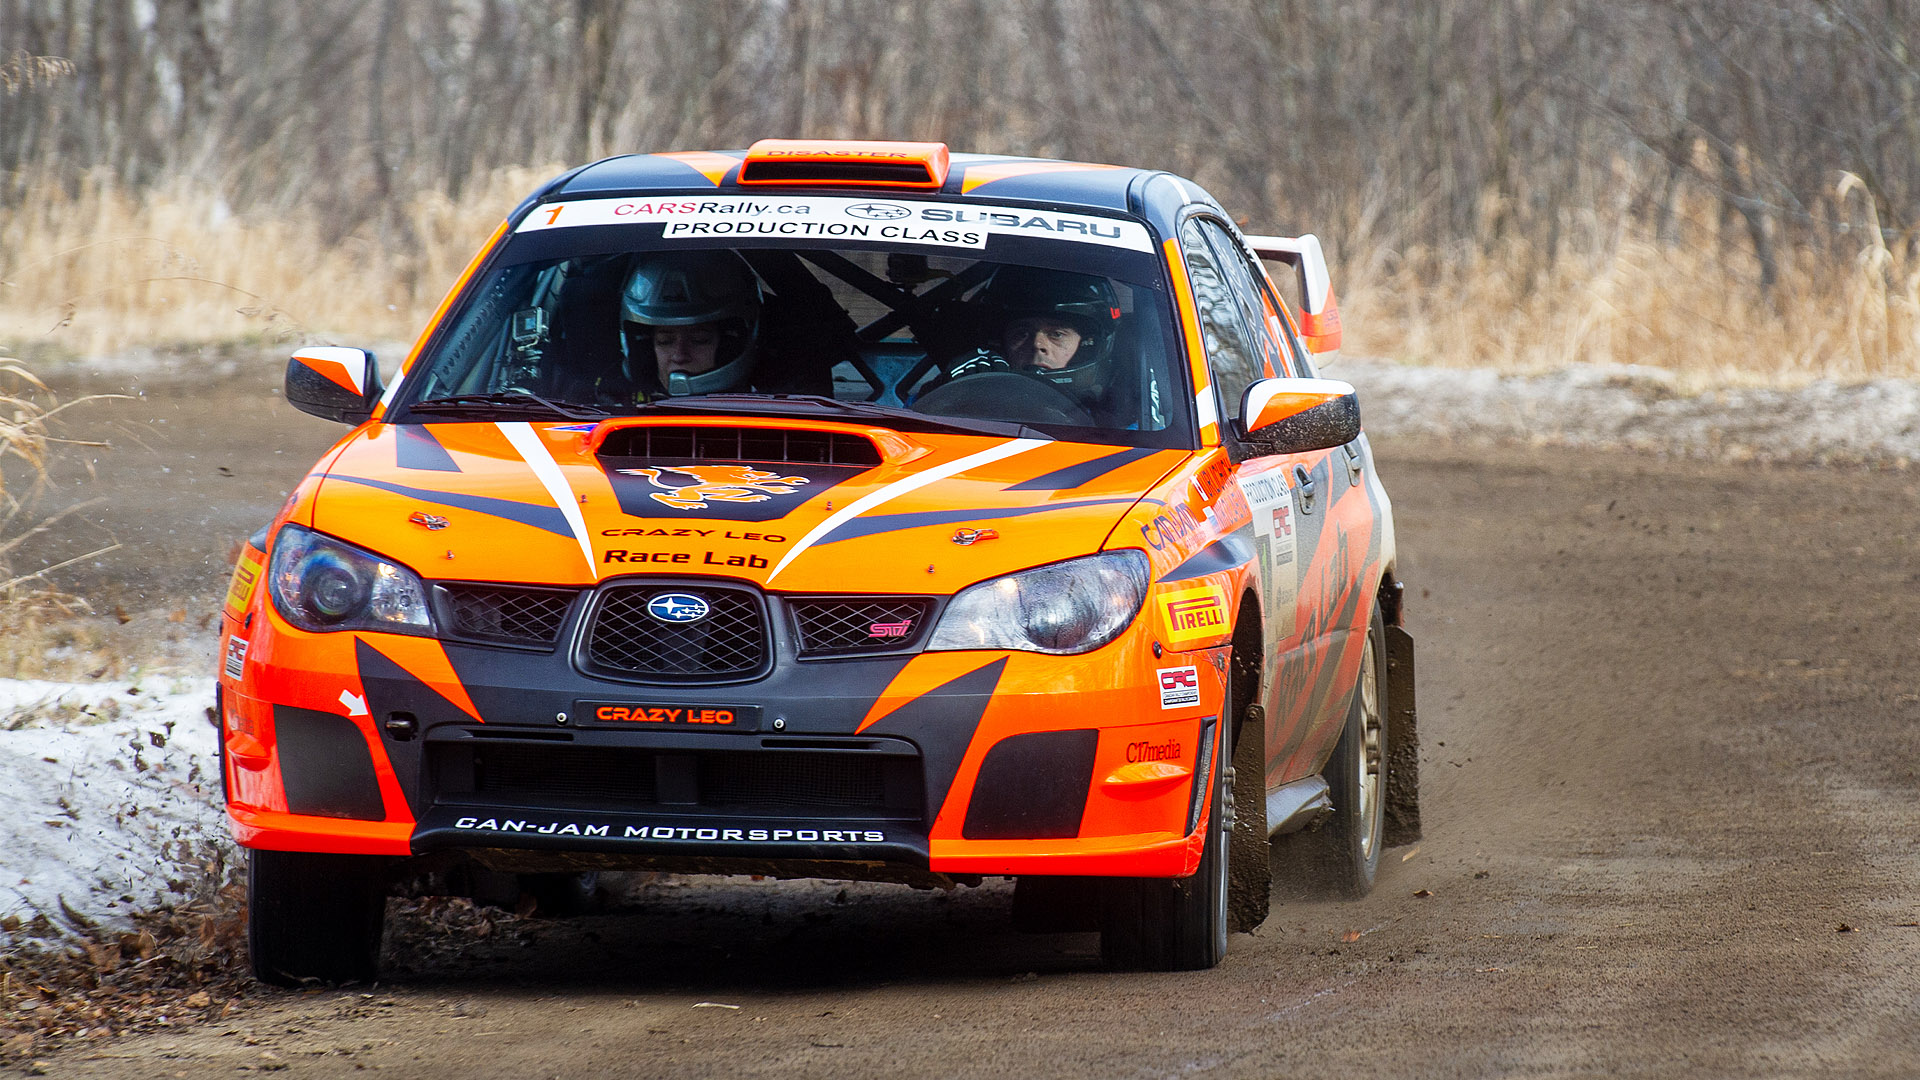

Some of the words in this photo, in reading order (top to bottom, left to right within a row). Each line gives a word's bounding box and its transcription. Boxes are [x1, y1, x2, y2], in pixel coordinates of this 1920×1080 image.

[767, 150, 908, 159] DISASTER
[545, 205, 564, 226] 1
[614, 201, 811, 217] CARSRally.ca
[671, 222, 870, 237] PRODUCTION
[881, 226, 980, 245] CLASS
[921, 208, 1121, 239] SUBARU
[601, 528, 717, 537] CRAZY
[724, 530, 787, 543] LEO
[603, 549, 691, 564] Race
[703, 550, 769, 569] Lab
[1167, 595, 1225, 632] PIRELLI
[1160, 669, 1197, 690] CRC
[596, 706, 683, 723] CRAZY
[687, 708, 734, 724] LEO
[1126, 738, 1182, 764] C17media
[454, 816, 610, 837] CAN-JAM
[623, 825, 885, 843] MOTORSPORTS
